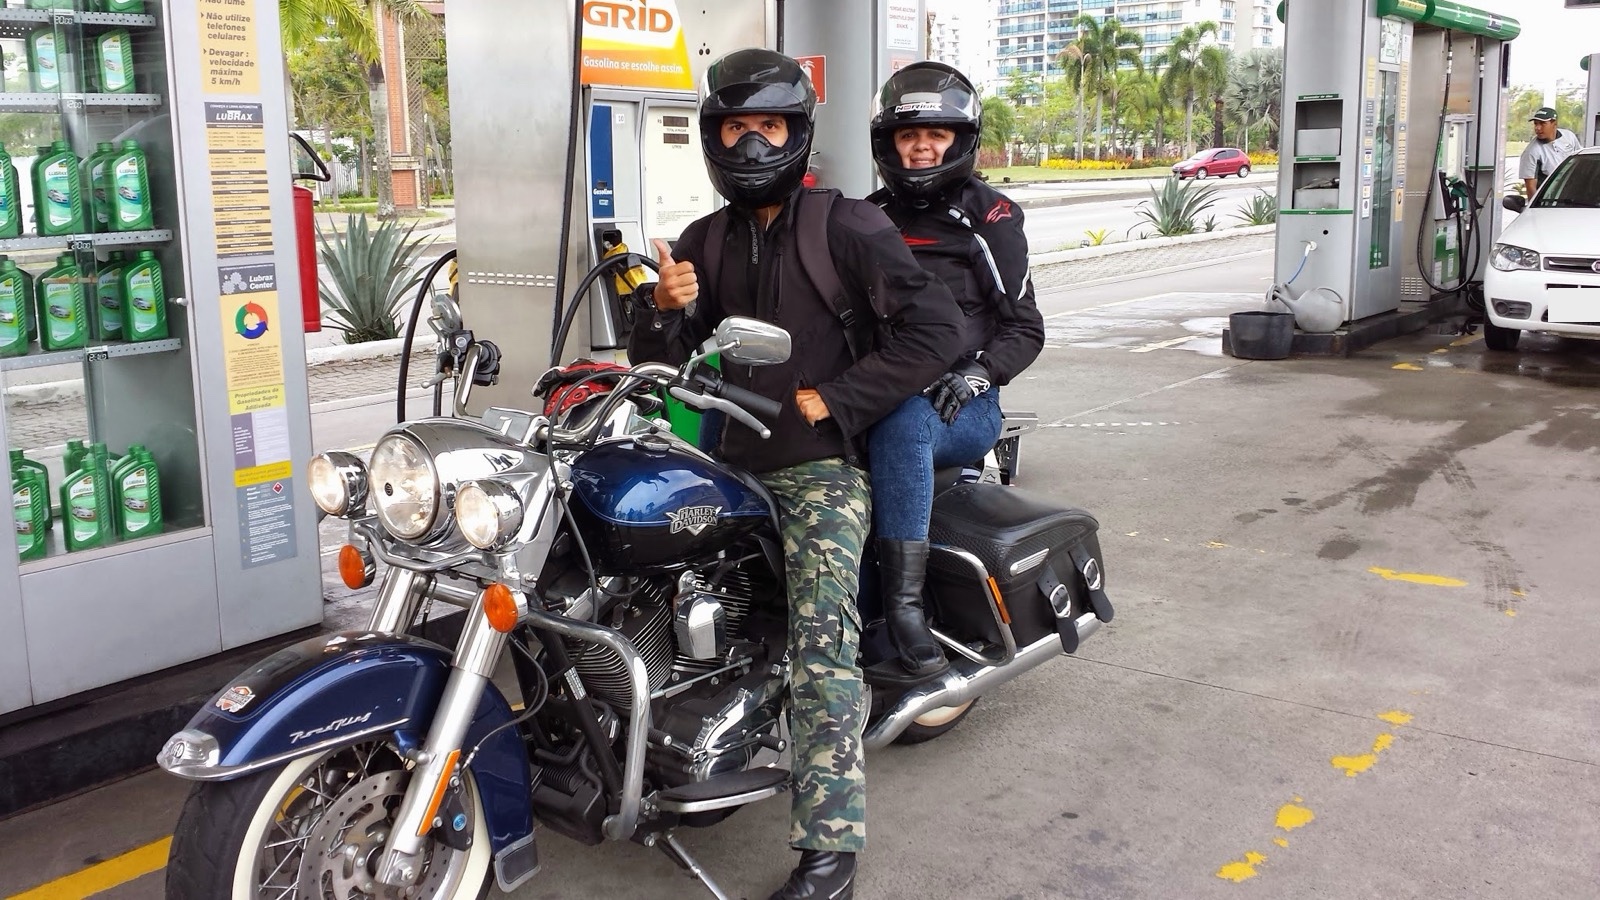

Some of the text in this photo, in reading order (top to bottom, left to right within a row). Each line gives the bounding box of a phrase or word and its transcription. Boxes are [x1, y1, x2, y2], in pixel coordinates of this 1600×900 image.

[206, 12, 251, 22] Não utilize
[582, 0, 674, 33] GRID
[207, 22, 246, 31] telefones
[207, 32, 246, 41] celulares
[209, 48, 244, 58] Devagar
[209, 59, 255, 67] velocidade
[584, 56, 620, 69] Gasolina
[621, 61, 630, 70] se
[631, 62, 660, 73] escolhe
[210, 68, 243, 76] máxima
[211, 77, 241, 86] 5 km/h
[216, 111, 253, 120] LUBRAX
[249, 282, 274, 290] Center
[234, 389, 271, 399] Propriedades
[237, 397, 261, 405] Gasolina
[673, 515, 718, 531] DAVIDSON
